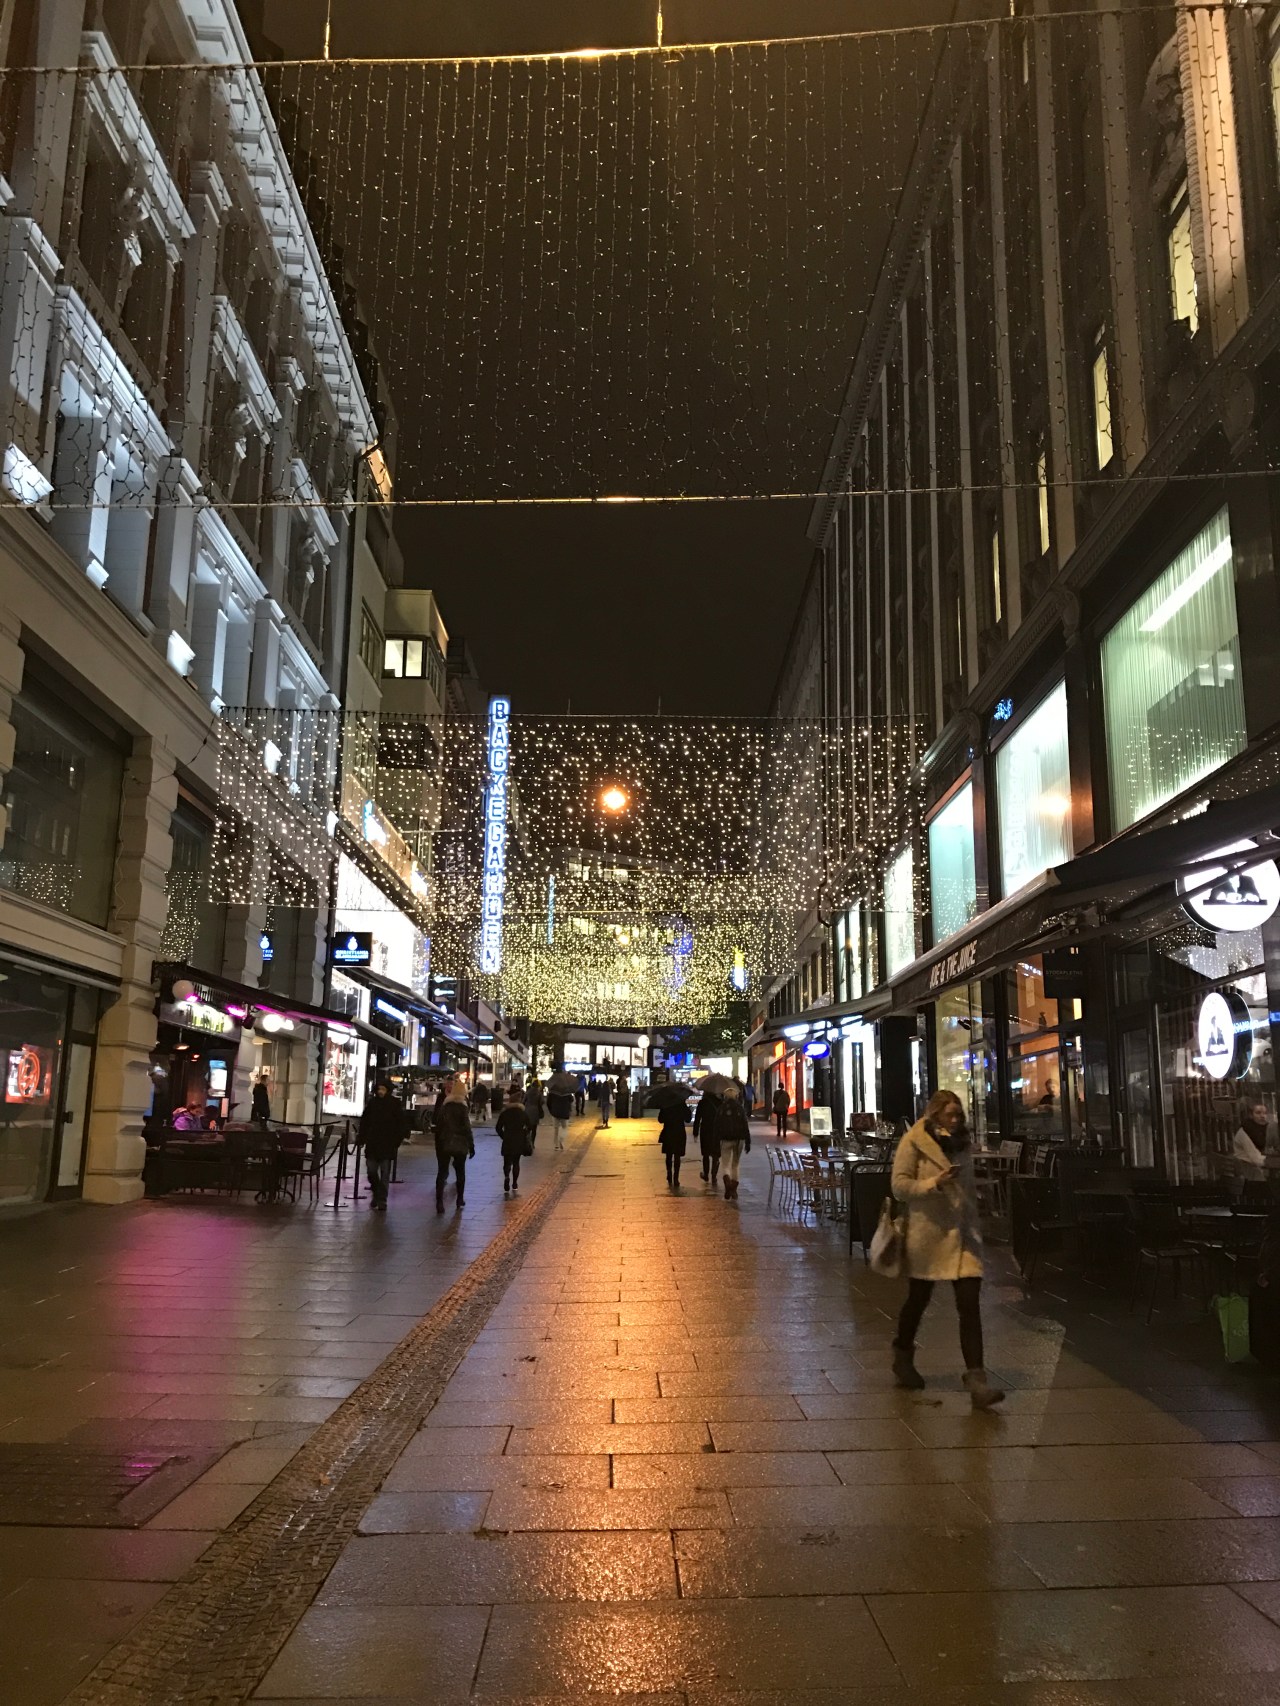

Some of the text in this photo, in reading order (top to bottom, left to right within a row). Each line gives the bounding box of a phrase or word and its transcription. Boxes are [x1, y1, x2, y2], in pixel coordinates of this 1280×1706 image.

[930, 962, 942, 989] JOE
[946, 951, 959, 980] THE
[957, 939, 978, 973] JUICE
